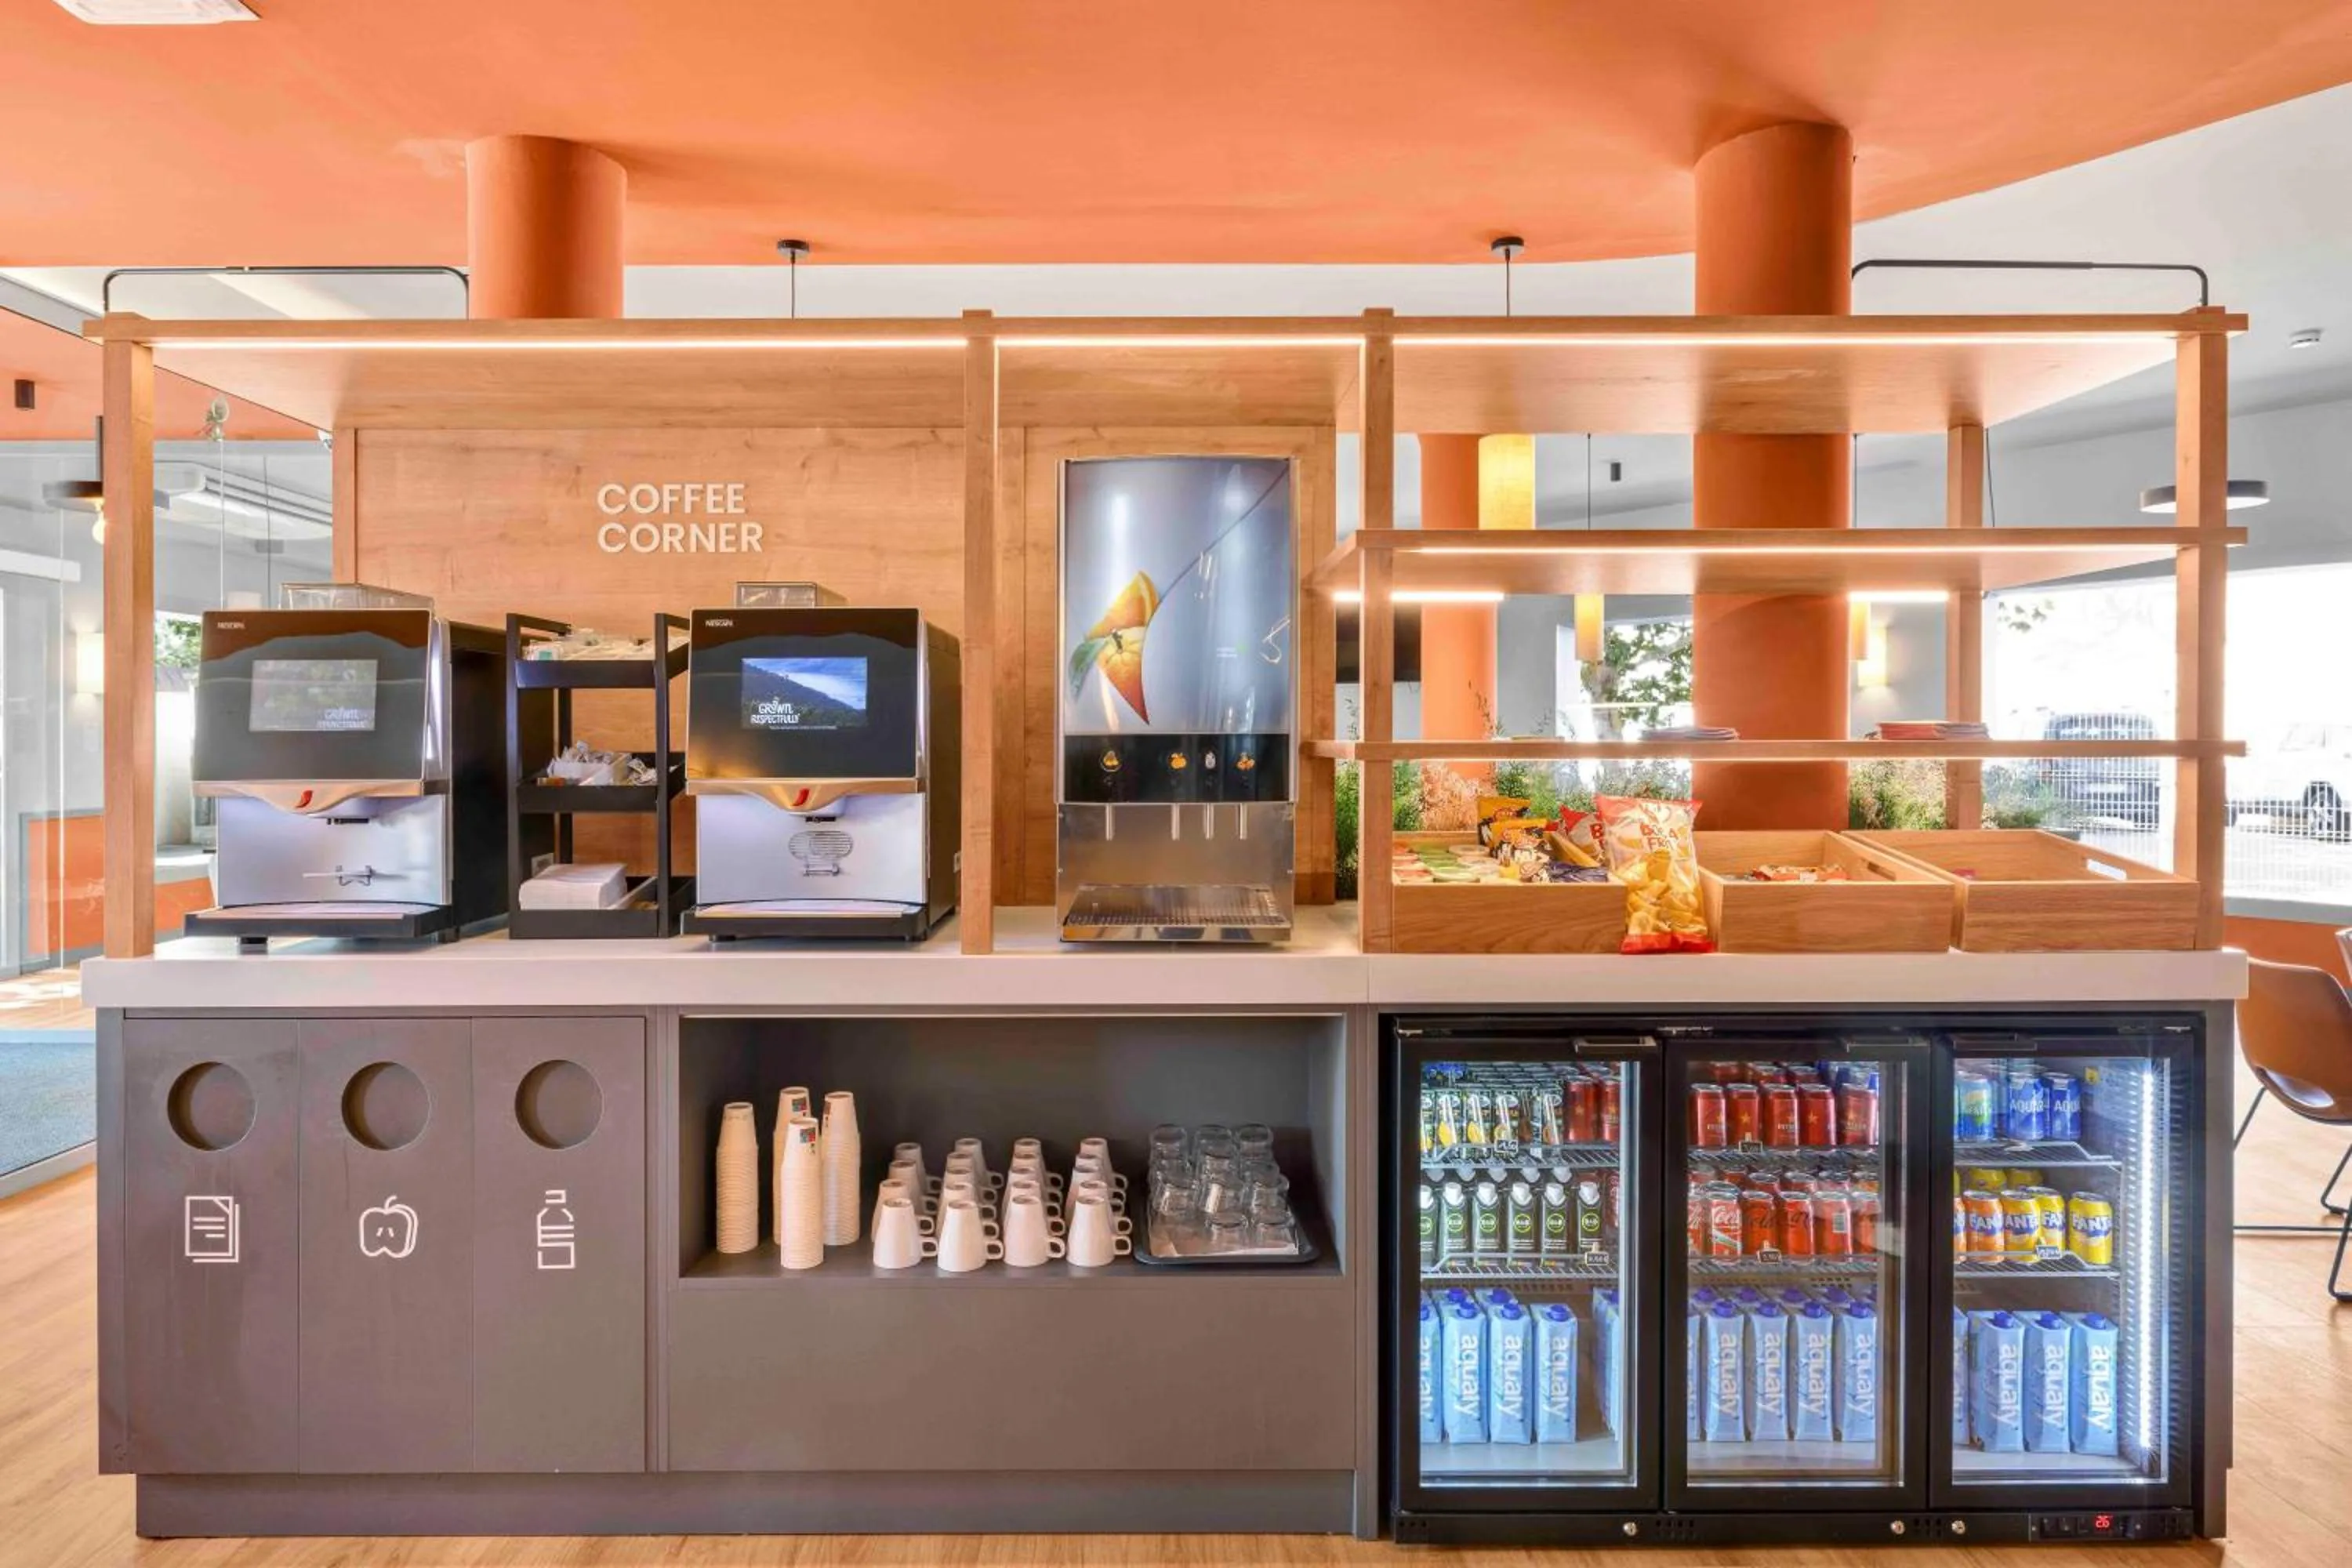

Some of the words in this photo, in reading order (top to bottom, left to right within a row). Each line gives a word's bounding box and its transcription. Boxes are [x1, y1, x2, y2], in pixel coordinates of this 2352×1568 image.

[597, 483, 745, 514] COFFEE
[597, 522, 763, 553] CORNER
[2010, 1100, 2044, 1113] AQUAR
[1454, 1334, 1480, 1419] aqualy
[1497, 1334, 1523, 1420] aqualy
[1542, 1337, 1570, 1420] aqualy
[1712, 1334, 1740, 1417] aqualy
[1755, 1333, 1784, 1417] aqualy
[1798, 1334, 1828, 1417] aqualy
[1846, 1334, 1874, 1417] aqualy
[1991, 1344, 2018, 1428] aqualy
[2035, 1345, 2066, 1429] aqualy
[2082, 1344, 2113, 1431] aqualy
